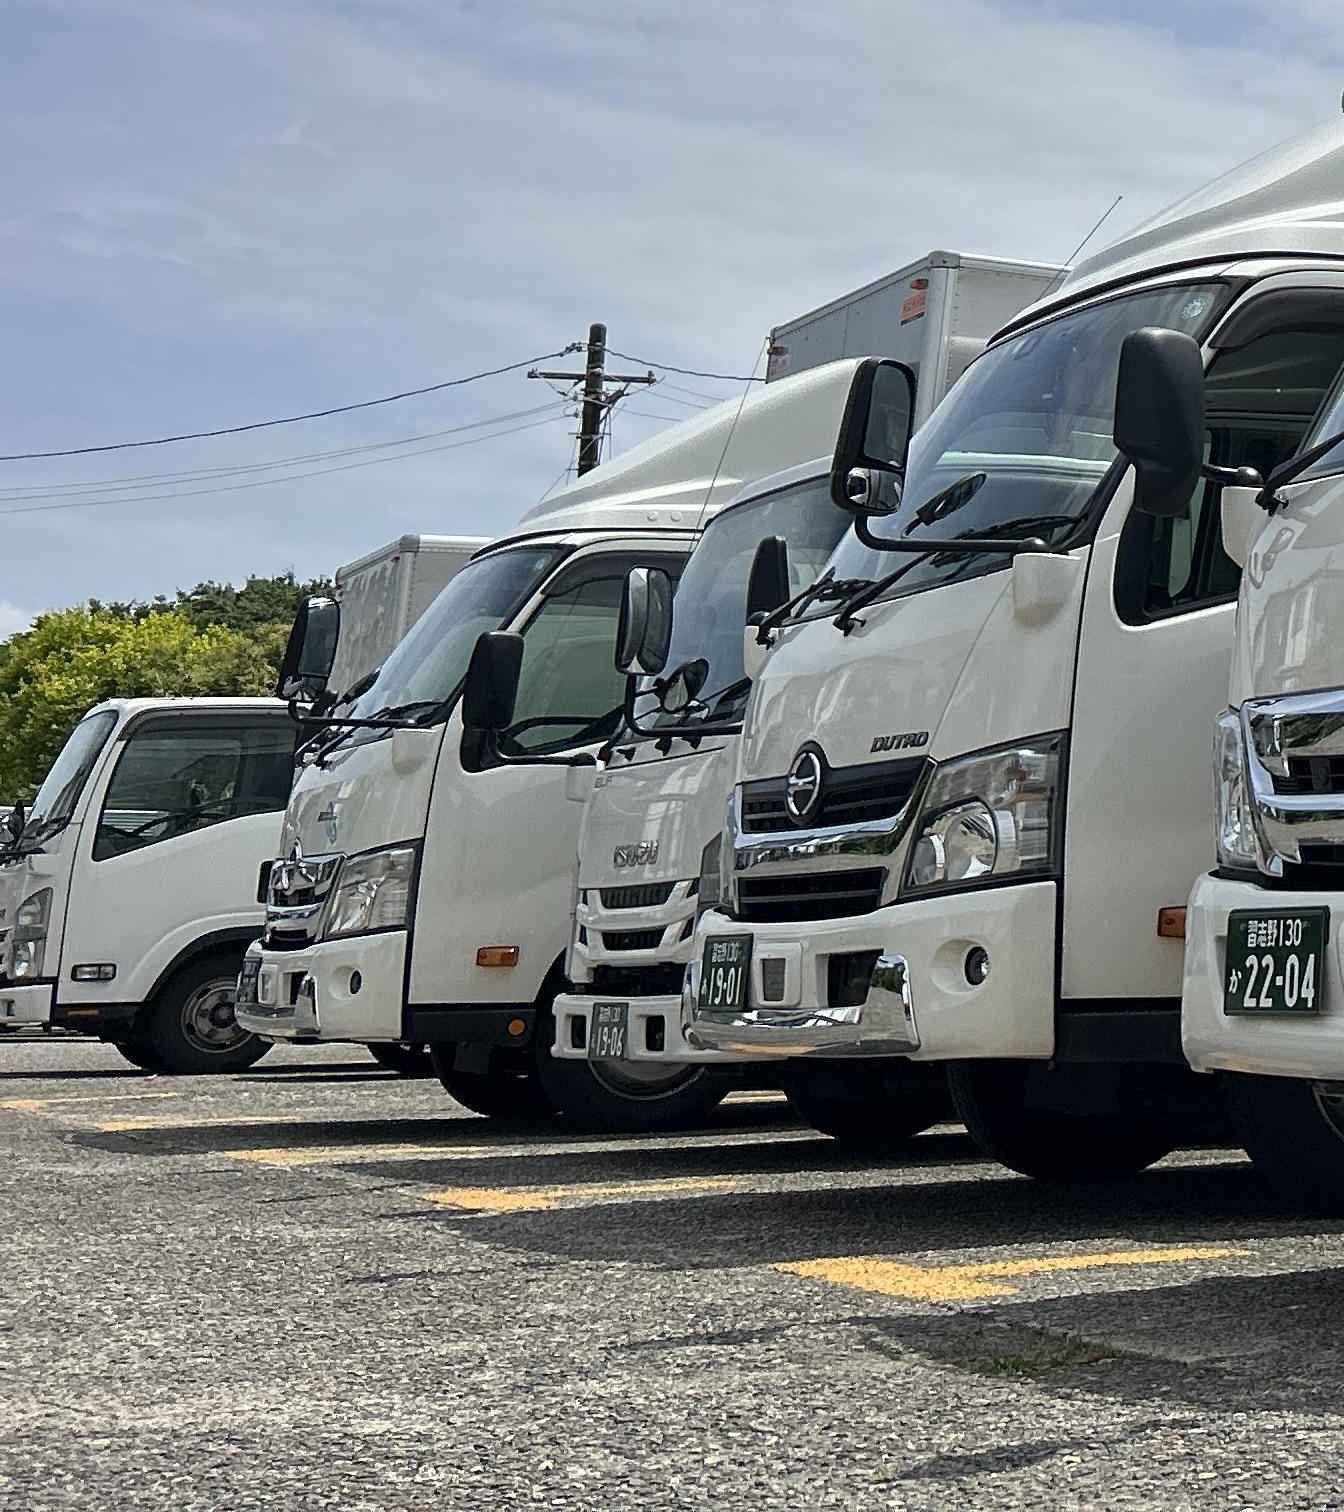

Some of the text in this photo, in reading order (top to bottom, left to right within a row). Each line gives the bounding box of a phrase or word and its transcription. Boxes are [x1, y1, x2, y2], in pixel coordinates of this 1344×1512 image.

[870, 732, 929, 753] DUTRO
[613, 840, 659, 868] ISUZU
[1243, 953, 1315, 1008] 22-04
